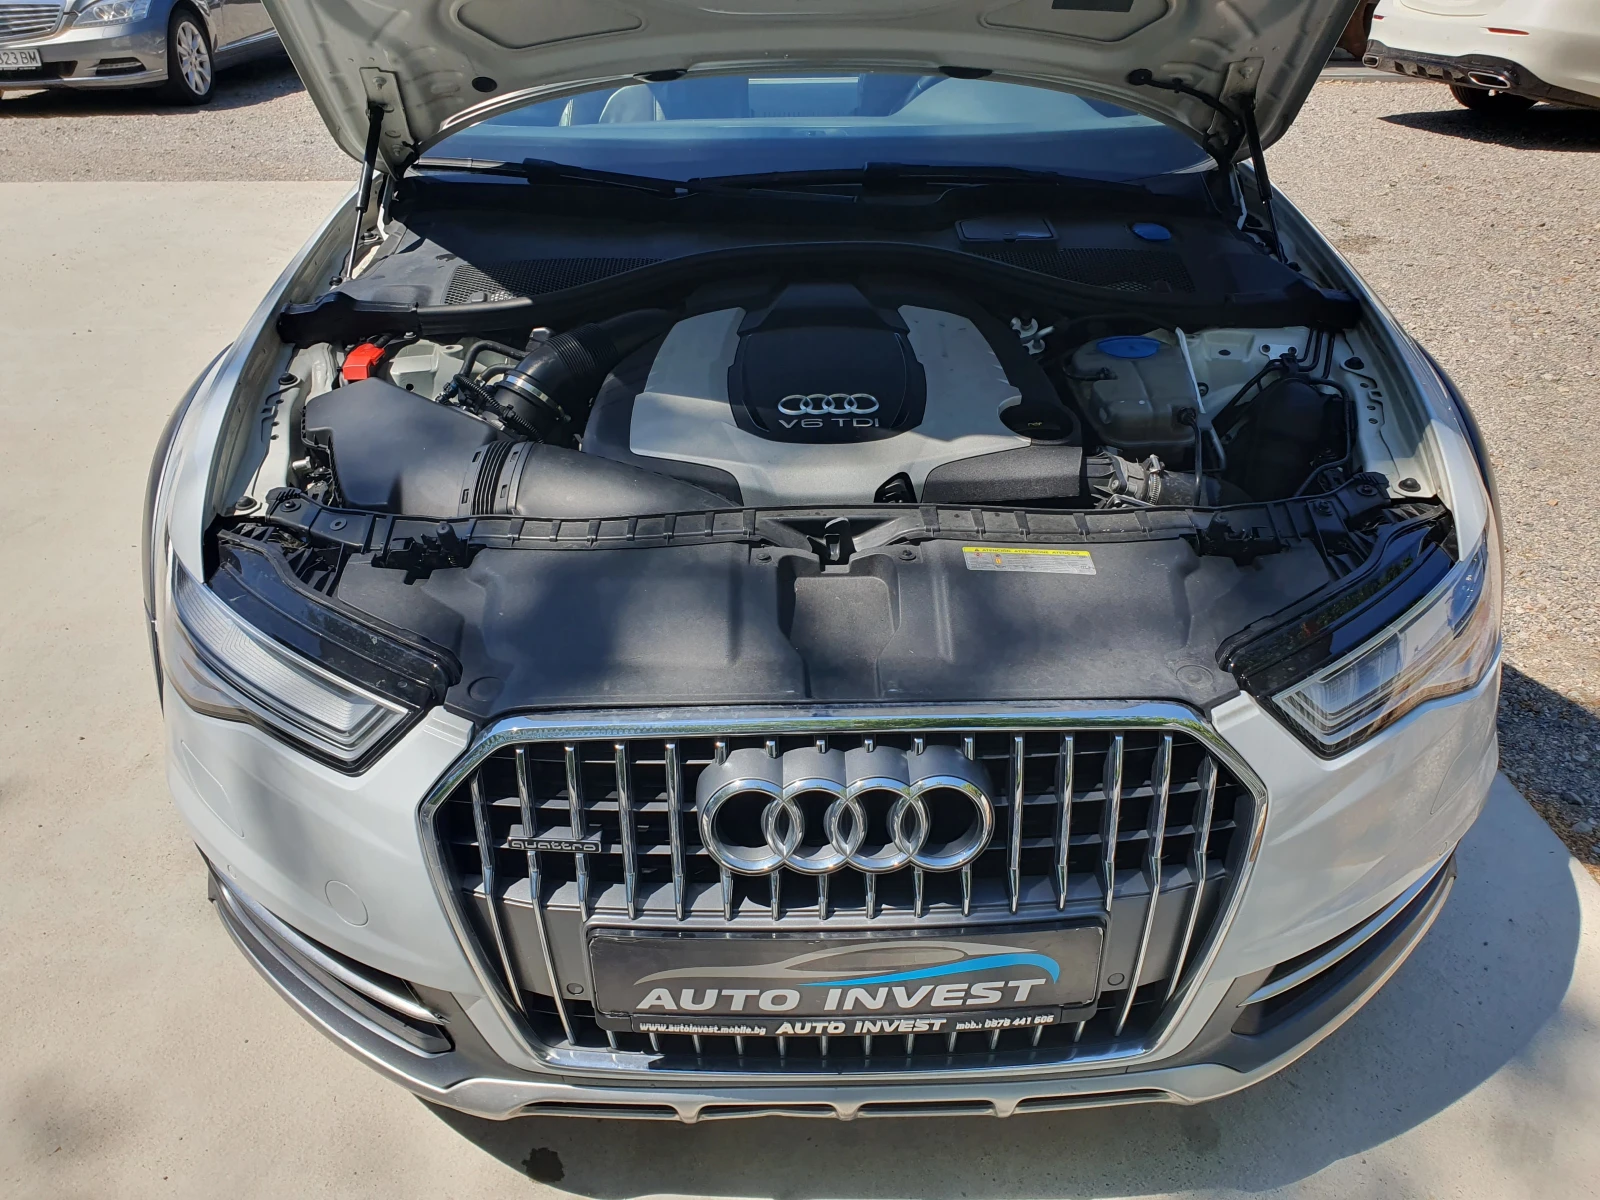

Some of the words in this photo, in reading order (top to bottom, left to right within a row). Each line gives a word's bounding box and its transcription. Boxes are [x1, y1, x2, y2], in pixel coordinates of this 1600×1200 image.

[20, 51, 38, 64] BM
[778, 418, 823, 429] V6
[831, 418, 880, 428] TDI
[511, 840, 597, 851] quattro
[636, 988, 800, 1011] AUTO
[823, 978, 1046, 1011] INVEST
[639, 1022, 767, 1036] www.autoinvest.mobile.bg
[775, 1021, 846, 1034] AUTO
[853, 1018, 947, 1034] INVEST
[1012, 1016, 1032, 1026] 441
